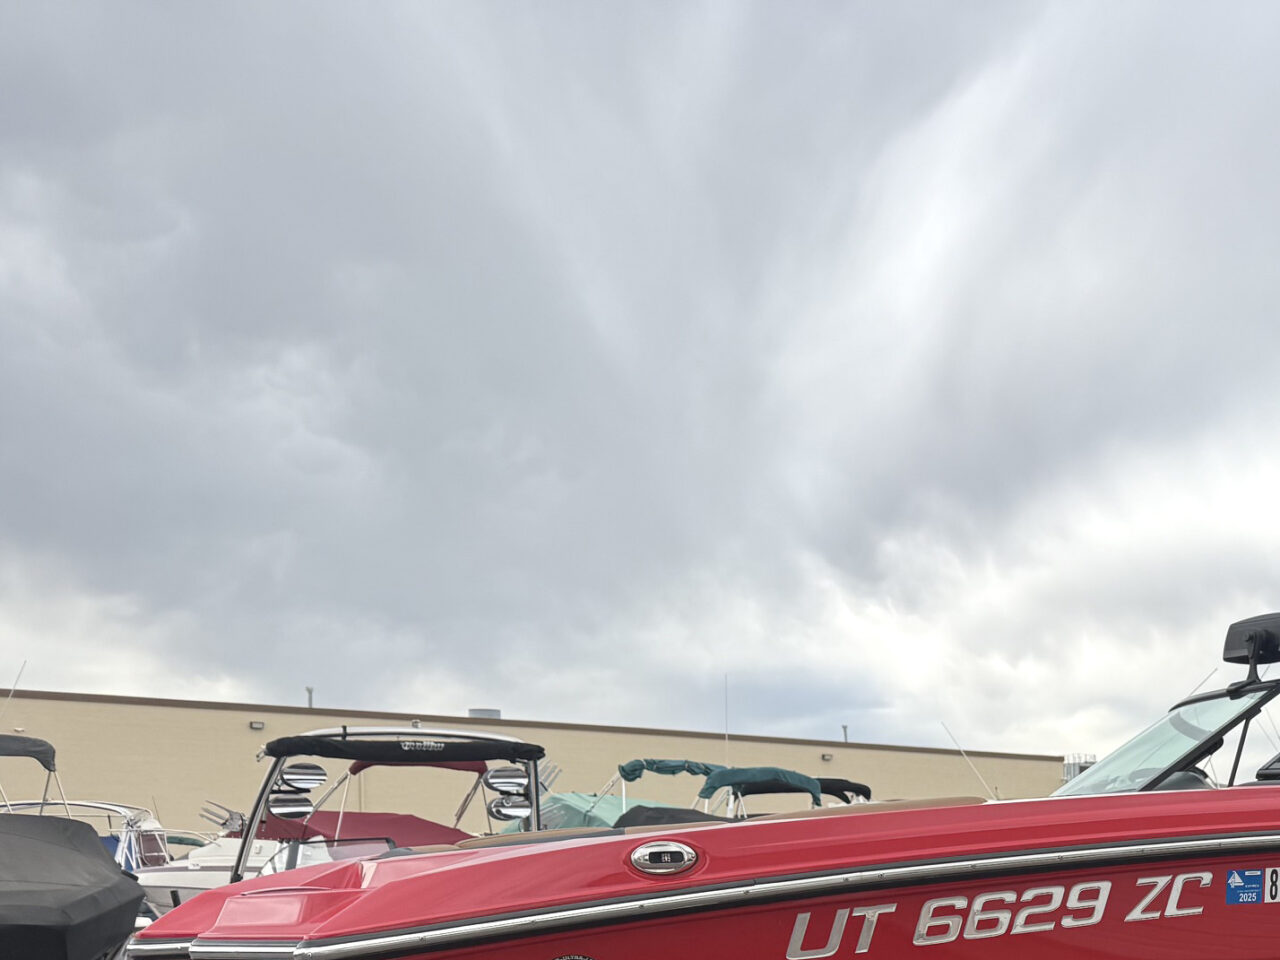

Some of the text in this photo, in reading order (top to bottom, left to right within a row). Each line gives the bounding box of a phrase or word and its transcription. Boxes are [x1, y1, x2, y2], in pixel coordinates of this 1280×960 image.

[1239, 892, 1257, 902] 2025
[1269, 868, 1279, 901] 8
[785, 872, 1213, 960] UT 6629 ZC
